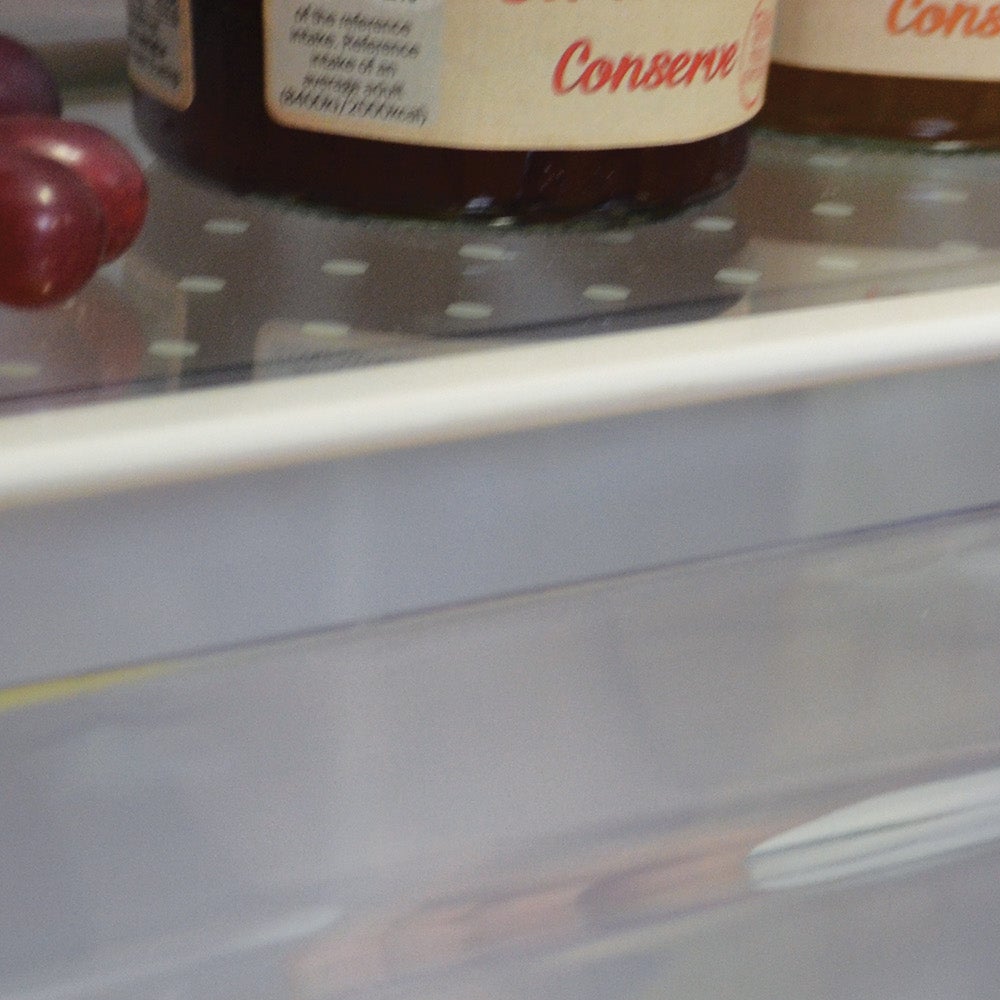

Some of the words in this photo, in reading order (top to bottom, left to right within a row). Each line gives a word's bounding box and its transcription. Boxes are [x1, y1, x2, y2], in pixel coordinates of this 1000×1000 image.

[339, 12, 414, 36] reference
[342, 33, 422, 58] Reference
[310, 52, 356, 71] intake
[358, 55, 376, 74] of
[376, 61, 398, 77] an
[552, 37, 739, 95] Conserve
[302, 72, 360, 94] average
[363, 80, 406, 100] adult
